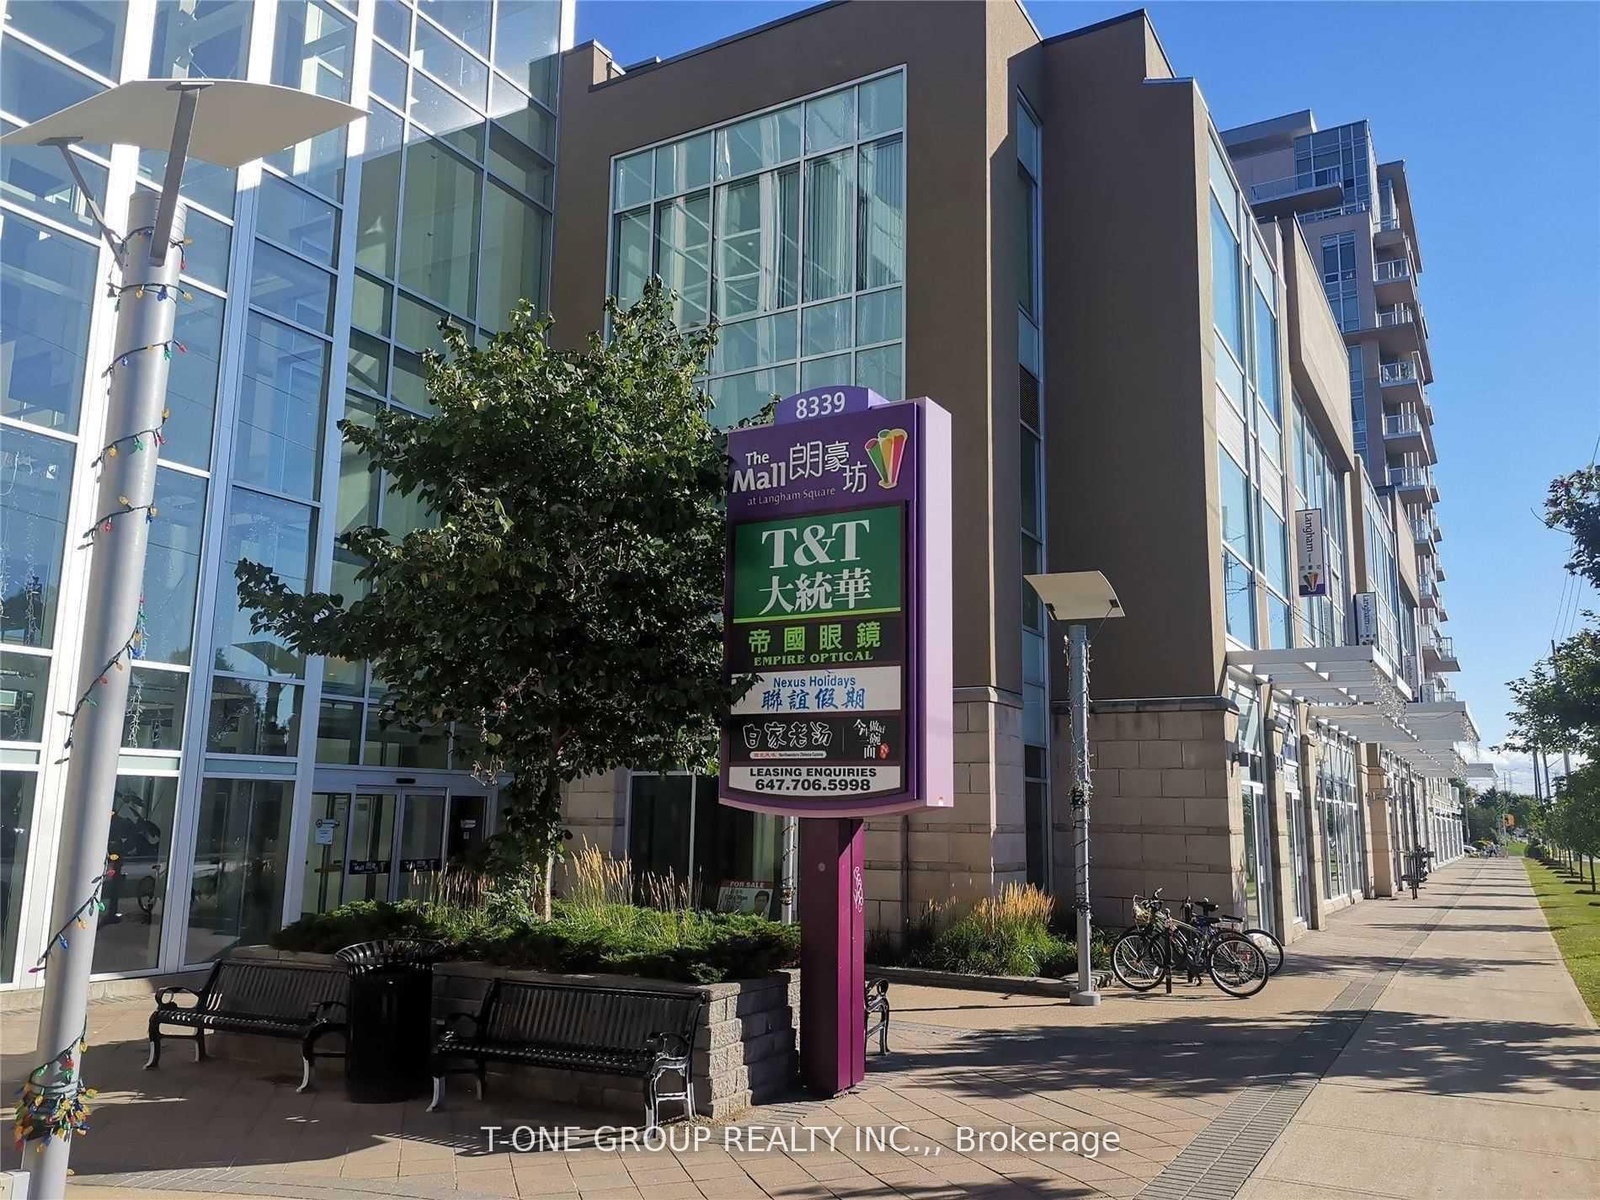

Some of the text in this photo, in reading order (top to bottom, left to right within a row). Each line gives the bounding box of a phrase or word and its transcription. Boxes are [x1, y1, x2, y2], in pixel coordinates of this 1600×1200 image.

[796, 391, 846, 419] 8339
[745, 451, 770, 466] The
[789, 440, 868, 493] 朗豪坊
[732, 461, 786, 493] Mall
[747, 486, 836, 506] at Langham Square
[761, 519, 870, 569] T&T
[1302, 512, 1315, 553] Langham
[759, 567, 872, 615] 大統華
[748, 621, 881, 654] 帝國眼鏡
[754, 650, 874, 666] EMPIRE OPTICAL
[773, 675, 856, 689] Nexus Holidays
[761, 686, 866, 712] 聯誼假期
[750, 768, 877, 778] LEASING ENQUIRIES
[755, 779, 871, 791] 647.706.5998
